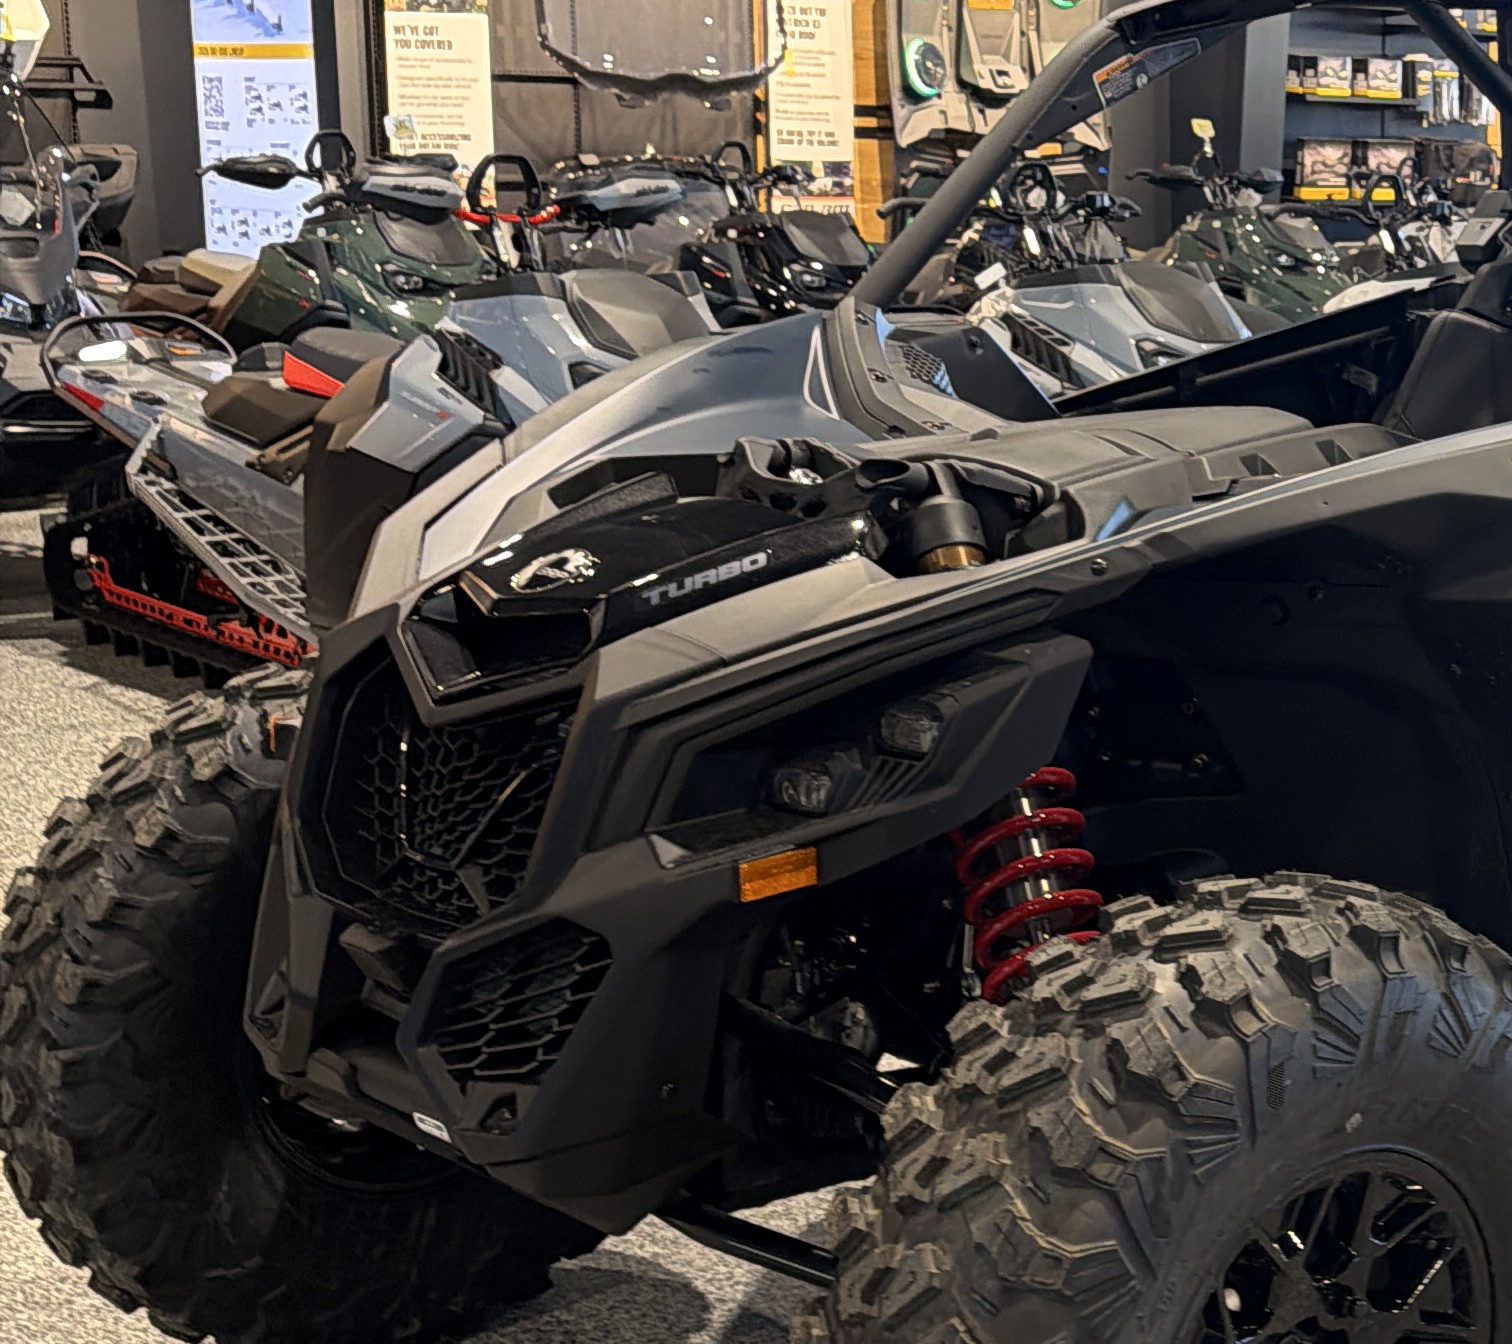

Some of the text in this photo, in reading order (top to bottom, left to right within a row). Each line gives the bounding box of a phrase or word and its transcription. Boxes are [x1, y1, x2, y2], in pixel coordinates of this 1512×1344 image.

[393, 38, 454, 51] YOU COVERED
[641, 551, 769, 607] TURBO
